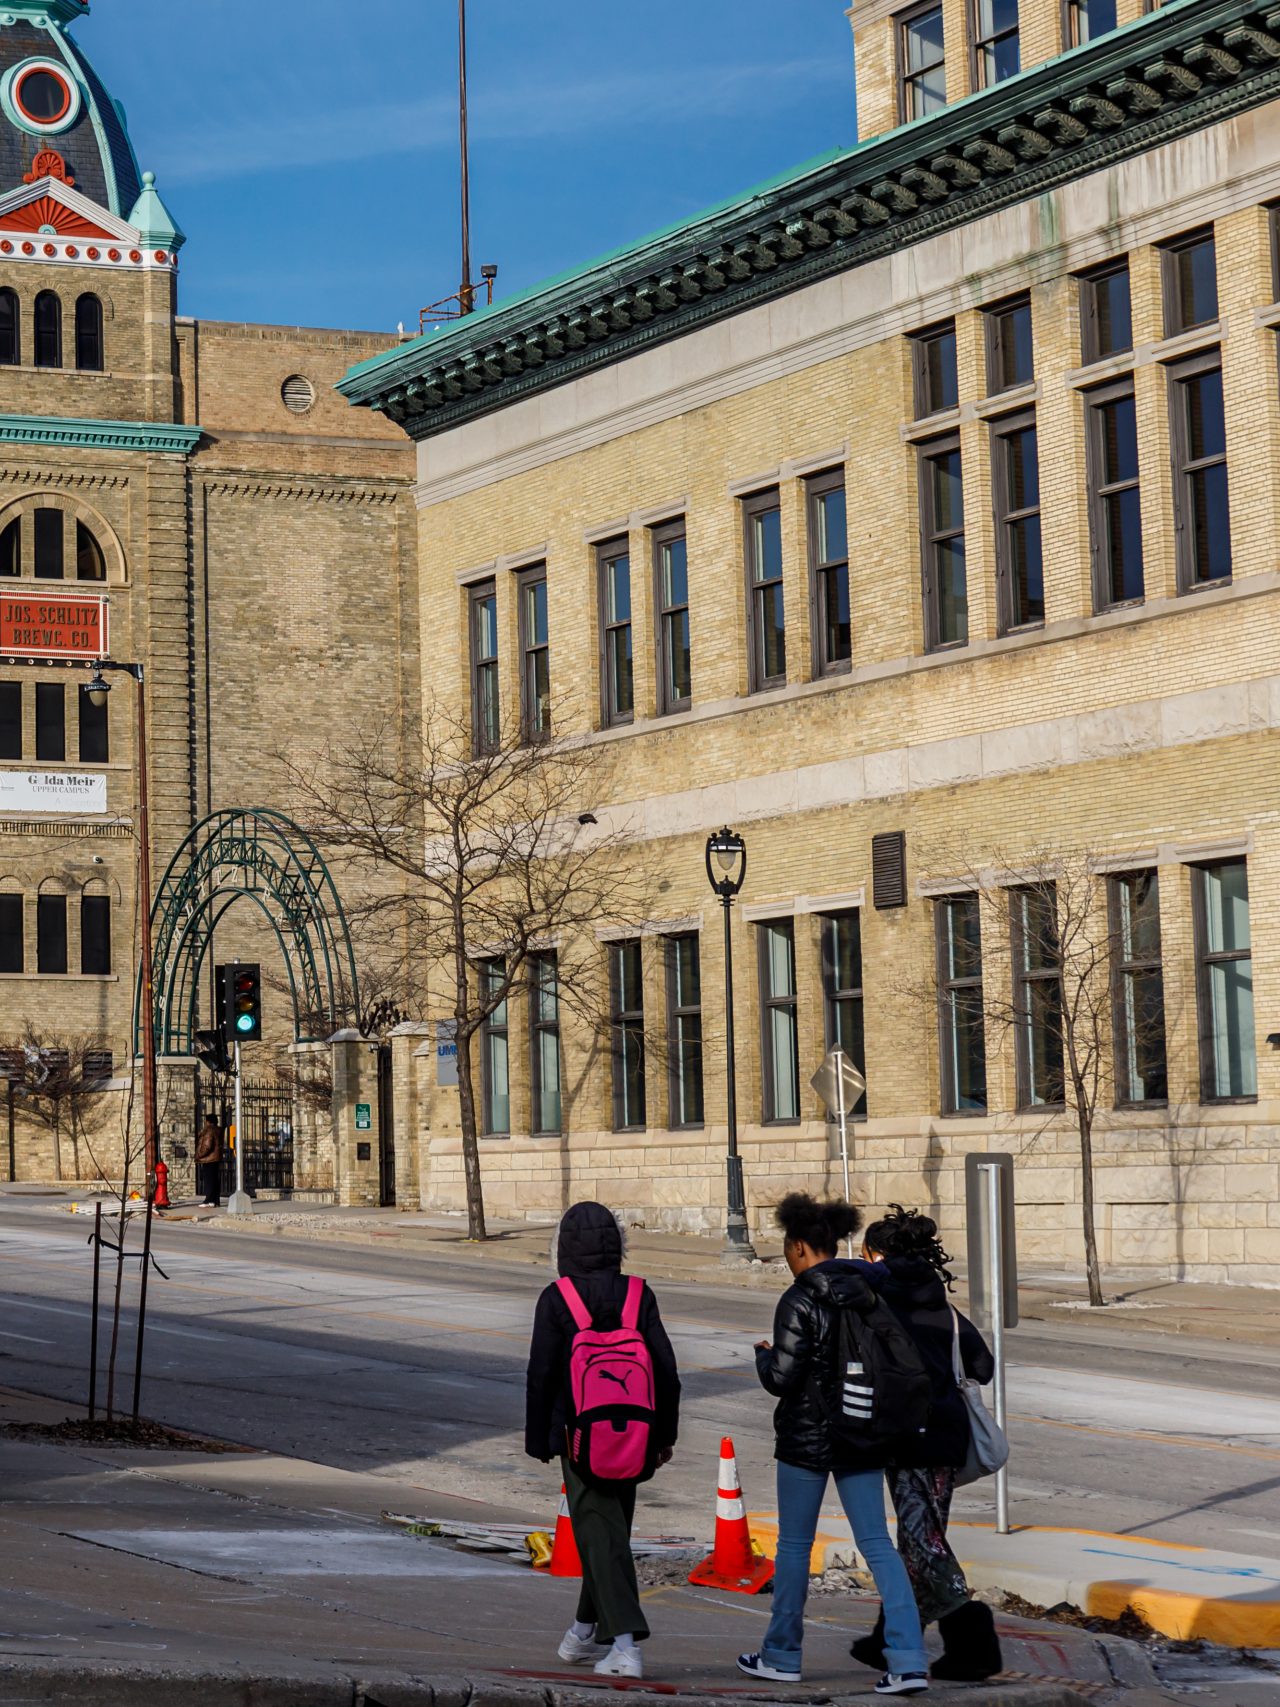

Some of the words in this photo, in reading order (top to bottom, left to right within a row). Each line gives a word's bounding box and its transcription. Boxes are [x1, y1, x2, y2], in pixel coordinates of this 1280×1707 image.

[5, 605, 34, 623] JOS.
[39, 606, 98, 626] SCHLITZ
[72, 630, 92, 648] CO.
[28, 775, 64, 785] Glda
[66, 776, 96, 786] Meir
[59, 786, 90, 794] CAMPUS
